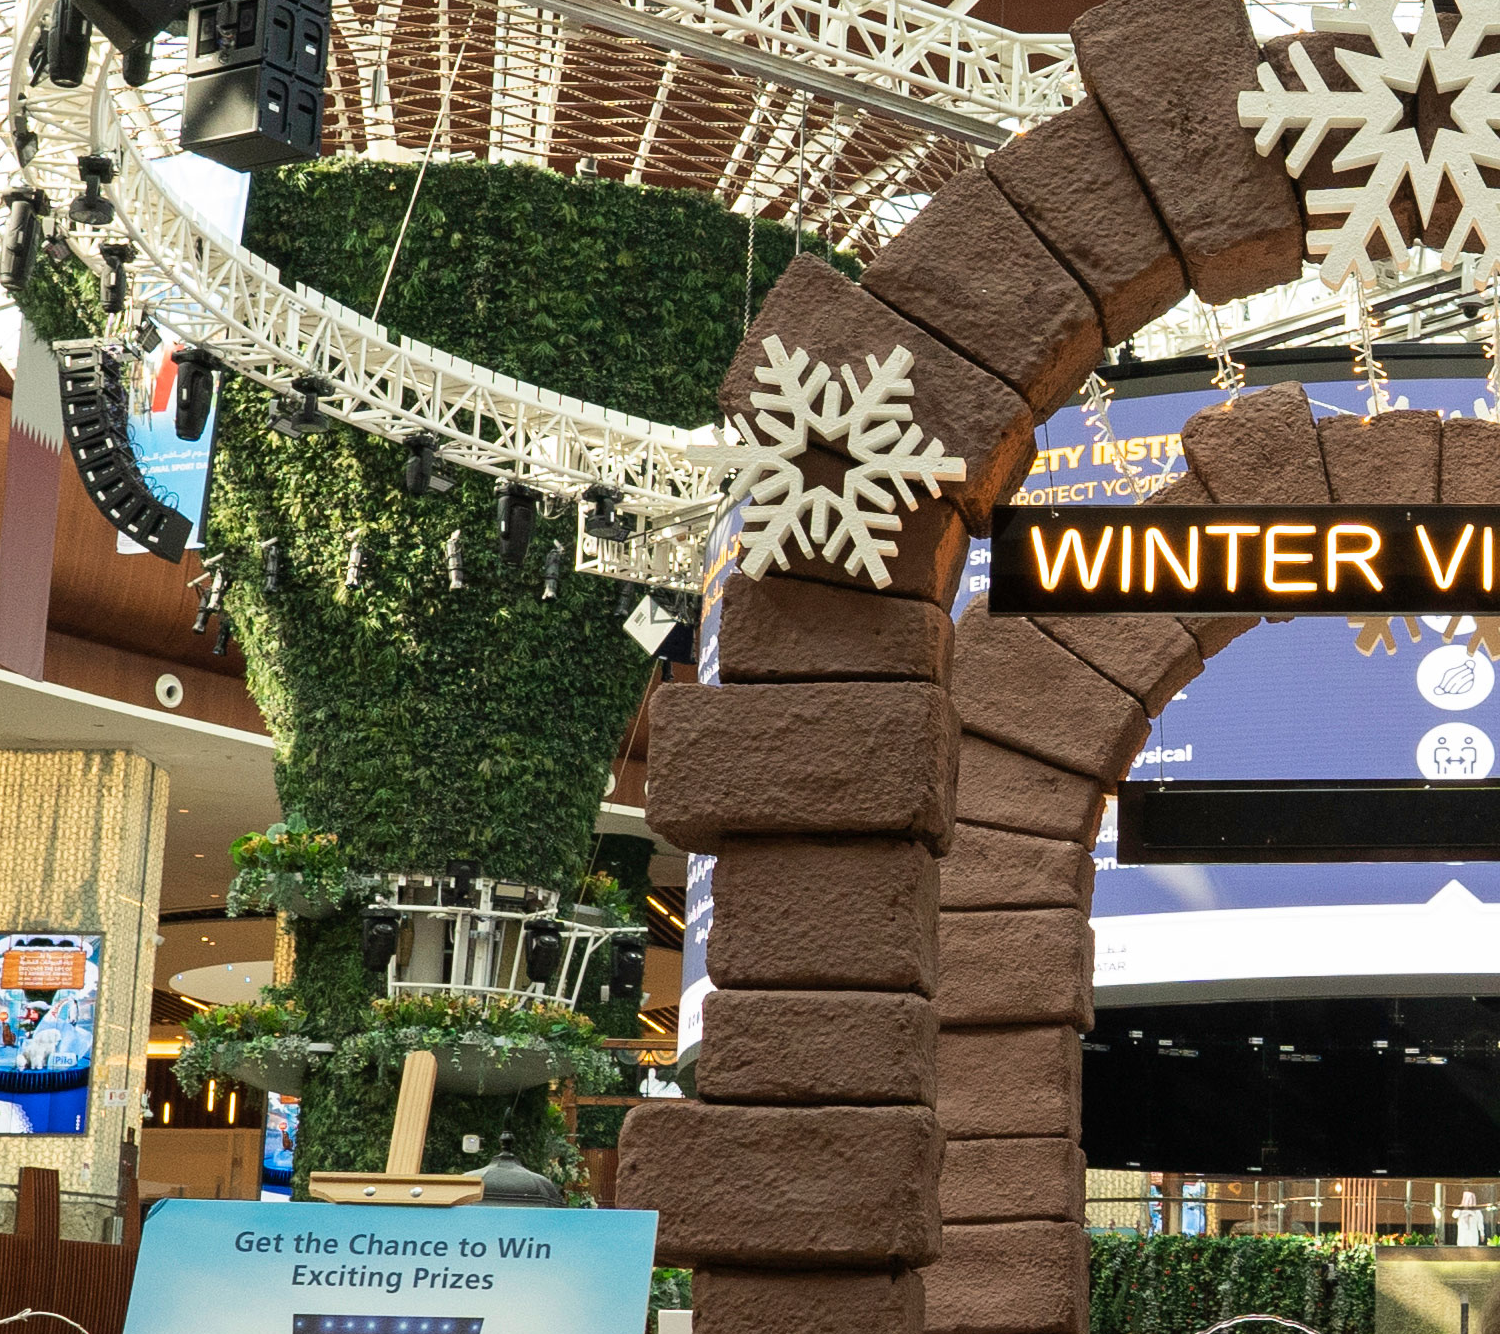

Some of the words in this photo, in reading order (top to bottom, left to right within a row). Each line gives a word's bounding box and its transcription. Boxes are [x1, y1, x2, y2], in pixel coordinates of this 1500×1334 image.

[1029, 445, 1085, 475] ETY
[1029, 523, 1385, 594] WINTER
[1131, 743, 1193, 771] ysical
[55, 1055, 73, 1066] Pilo
[234, 1230, 285, 1254] Get
[293, 1231, 339, 1255] the
[348, 1232, 449, 1257] Chance
[458, 1237, 487, 1258] to
[497, 1236, 552, 1260] Win
[291, 1264, 403, 1294] Exciting
[412, 1266, 494, 1290] Prizes
